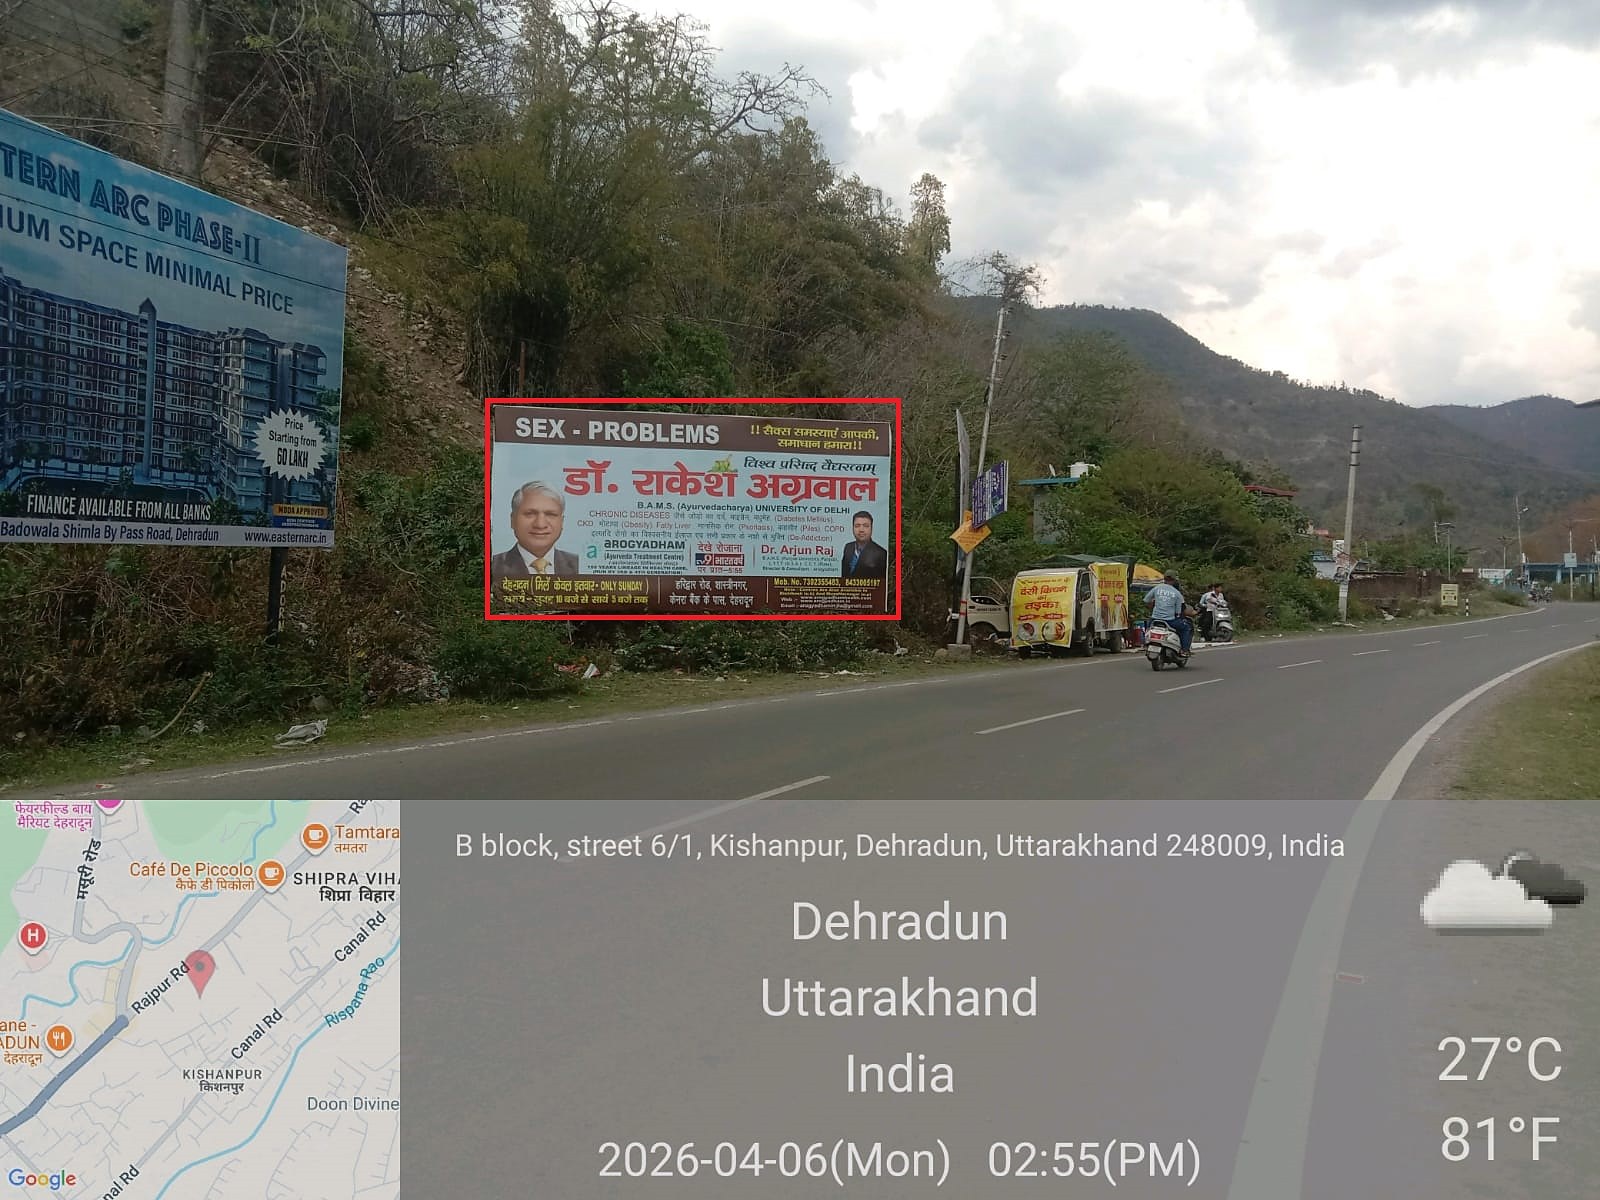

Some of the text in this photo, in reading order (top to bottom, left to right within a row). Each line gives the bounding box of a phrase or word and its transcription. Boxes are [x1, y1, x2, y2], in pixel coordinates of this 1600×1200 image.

[90, 179, 150, 226] ARC
[157, 201, 262, 265] PHASE-II
[59, 225, 138, 268] SPACE
[146, 252, 236, 297] MINIMAL
[242, 282, 293, 315] PRICE
[285, 418, 304, 430] Price
[515, 417, 566, 439] SEX
[588, 421, 720, 445] PROBLEMS
[269, 430, 317, 447] Starting from
[277, 448, 308, 468] 60 LAKH
[563, 460, 879, 505] डॉ. राकेश अग्रवाल
[27, 494, 211, 521] FINANCE AVAILABLE FROM ALL BANKS
[630, 511, 670, 519] DISEASES
[637, 502, 675, 510] B.A.M.S.
[677, 503, 753, 514] (Ayurvedacharya)
[755, 504, 808, 513] UNIVERSITY
[824, 506, 850, 514] DELHI
[0, 522, 219, 543] Badowala Shimla By Pass Road, Dehradun
[244, 532, 327, 544] www.easternarc.in
[604, 553, 633, 561] (Ayurveda
[634, 553, 663, 561] Treatment
[761, 544, 834, 557] Dr. Arjun Raj
[600, 581, 617, 591] ONLY
[618, 581, 643, 592] SUNDAY
